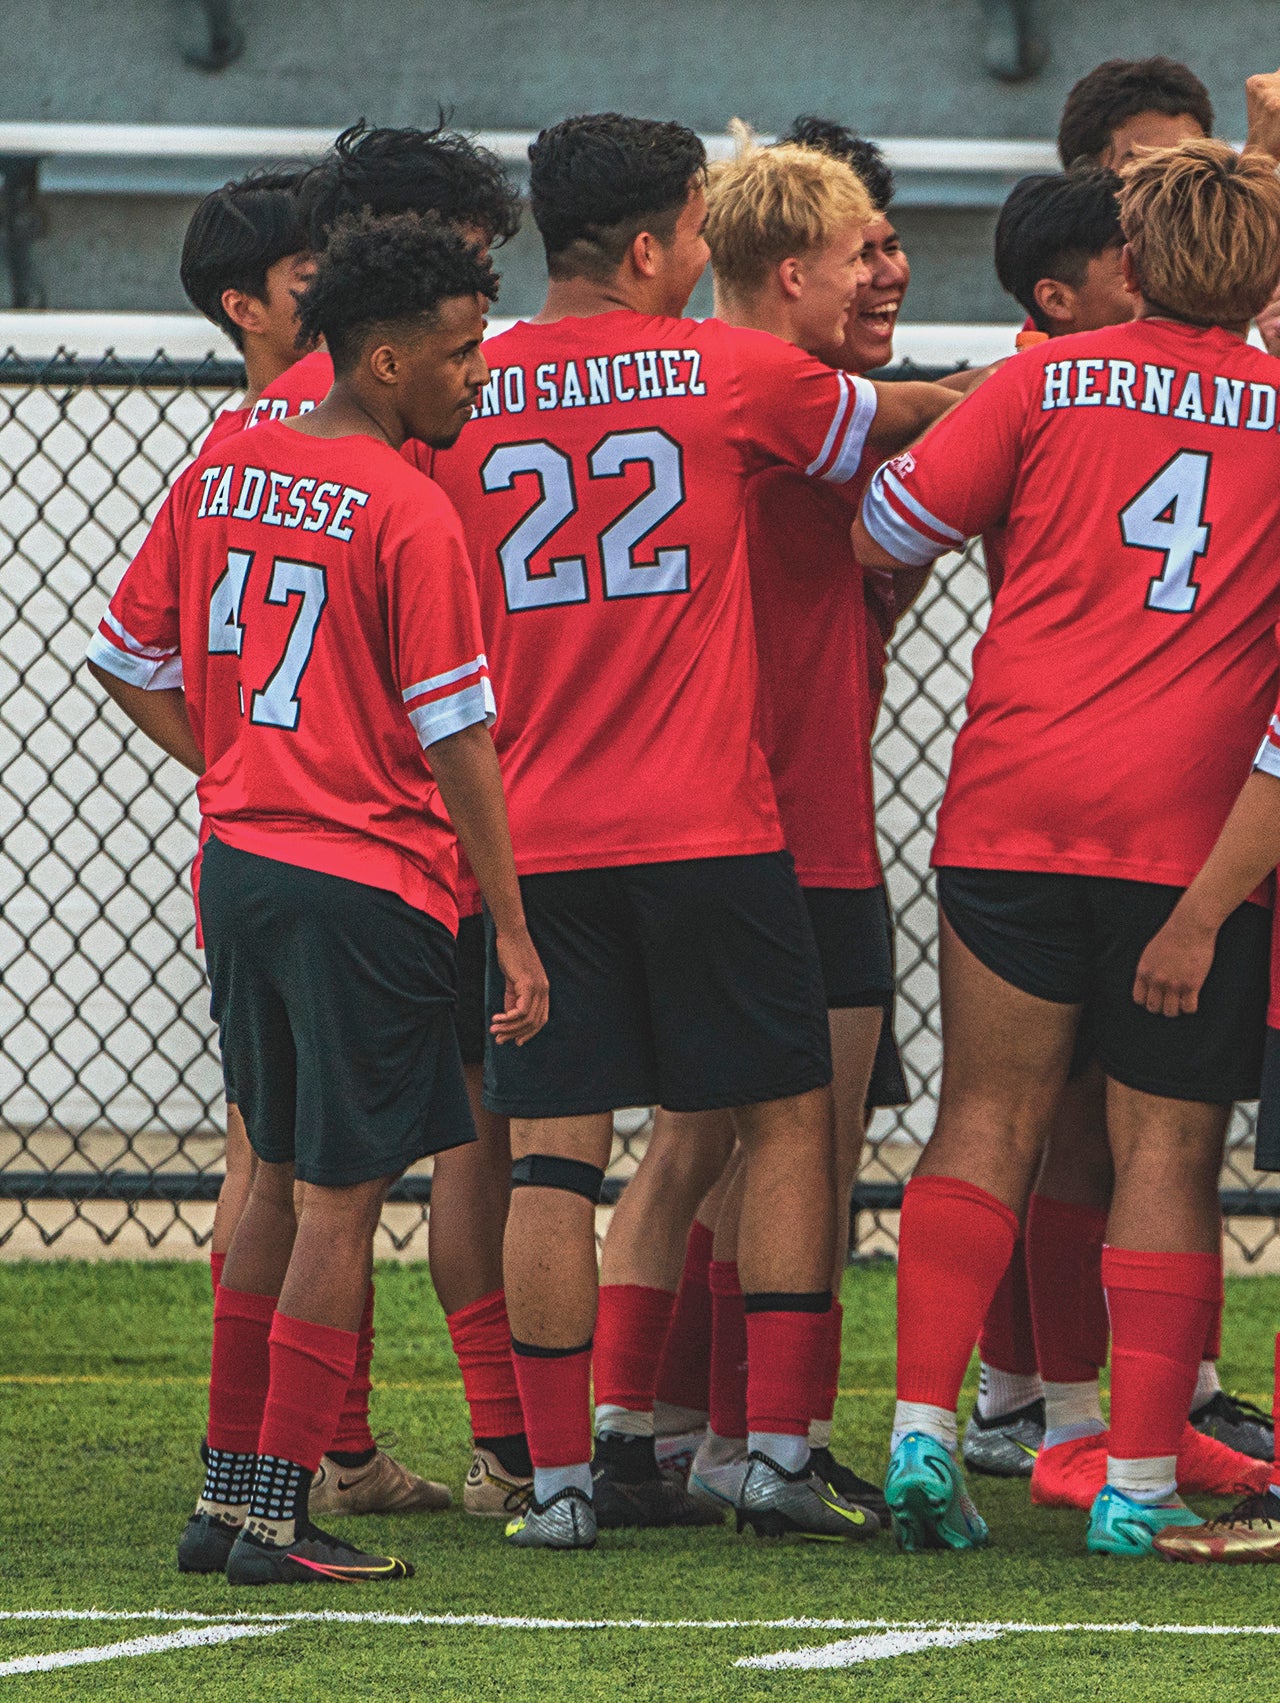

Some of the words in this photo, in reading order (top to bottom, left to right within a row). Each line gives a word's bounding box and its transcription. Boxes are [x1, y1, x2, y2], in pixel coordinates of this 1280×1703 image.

[469, 365, 526, 420] NO
[535, 348, 707, 411] SANCHEZ
[197, 465, 370, 542] TADESSE
[479, 425, 692, 615] 22
[1117, 447, 1214, 613] 4
[207, 546, 329, 732] 47
